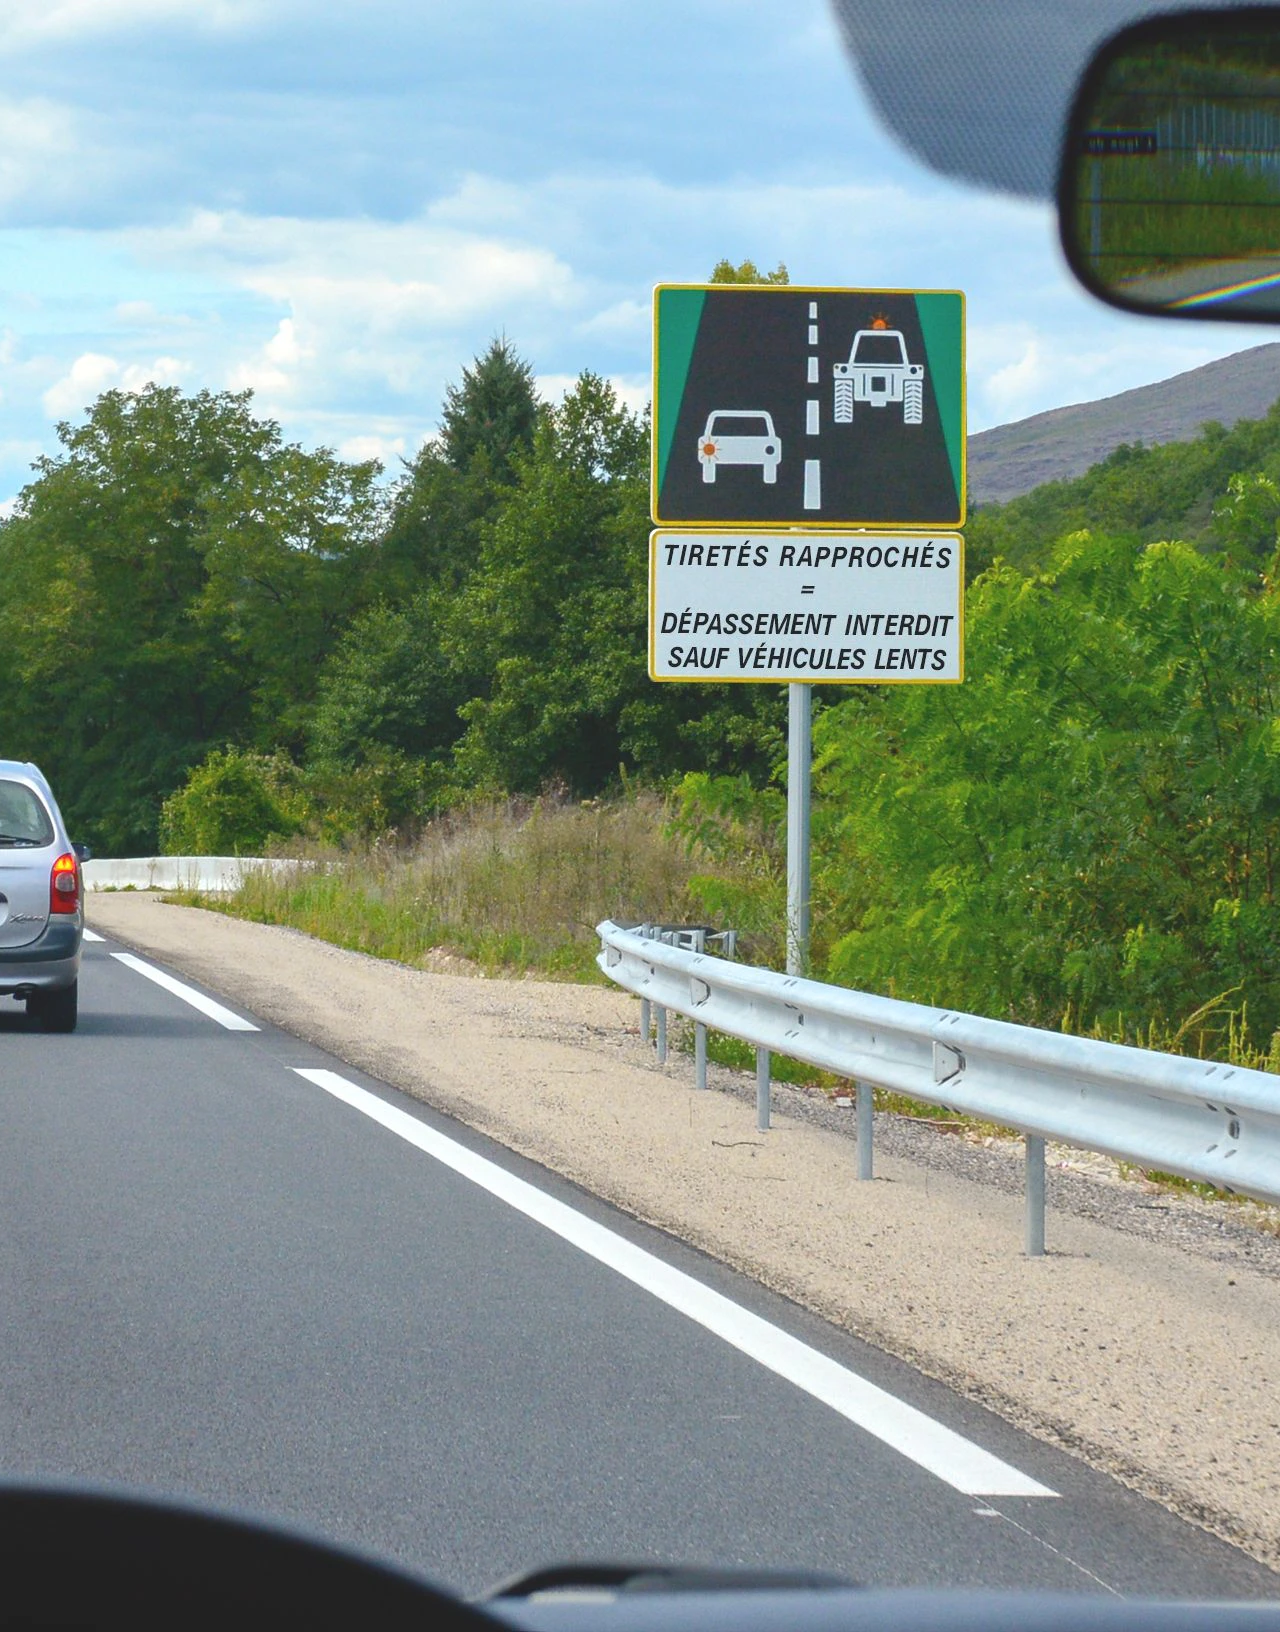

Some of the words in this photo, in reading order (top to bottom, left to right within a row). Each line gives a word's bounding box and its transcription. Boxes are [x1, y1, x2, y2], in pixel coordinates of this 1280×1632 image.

[664, 540, 769, 567] TIRETÉS
[779, 541, 952, 568] RAPPROCHÉS
[660, 607, 837, 635] DÉPASSEMENT
[844, 614, 954, 637] INTERDIT
[668, 646, 730, 668] SAUF
[738, 642, 867, 670] VÉHICULES
[874, 648, 947, 671] LENTS
